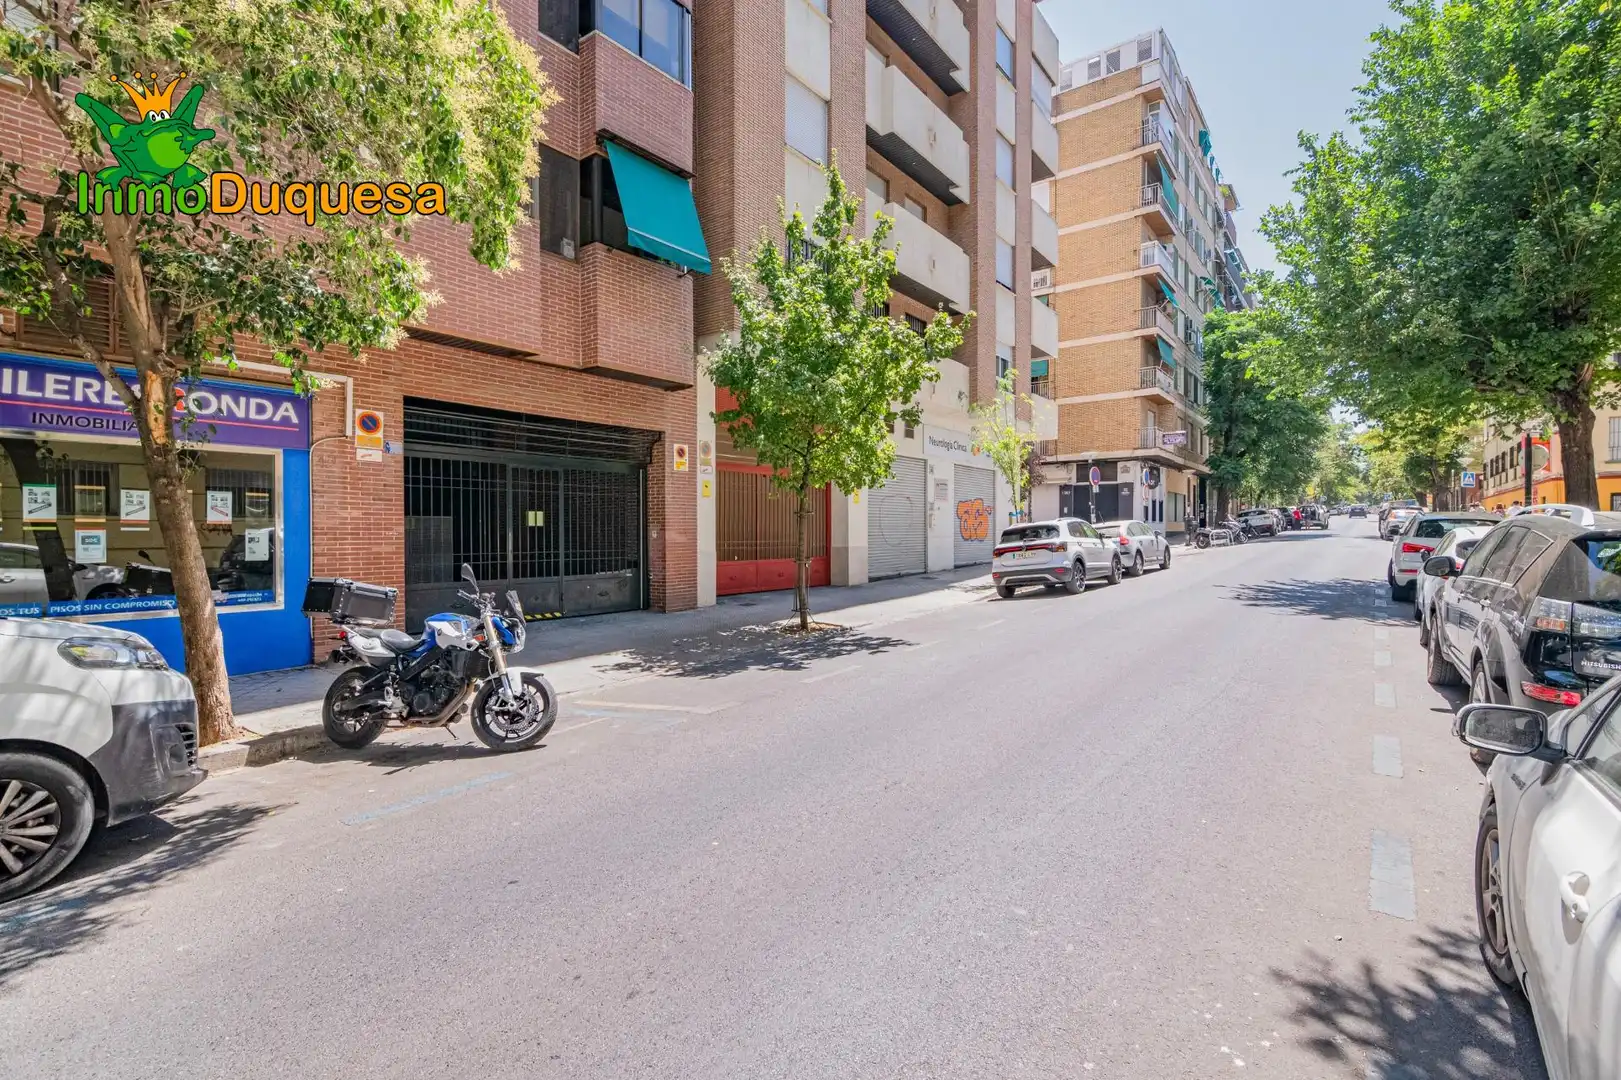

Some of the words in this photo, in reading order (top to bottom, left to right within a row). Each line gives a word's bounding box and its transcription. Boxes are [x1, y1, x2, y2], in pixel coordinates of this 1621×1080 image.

[19, 606, 40, 615] TUS
[50, 605, 82, 614] PISOS
[84, 603, 102, 612] SIN
